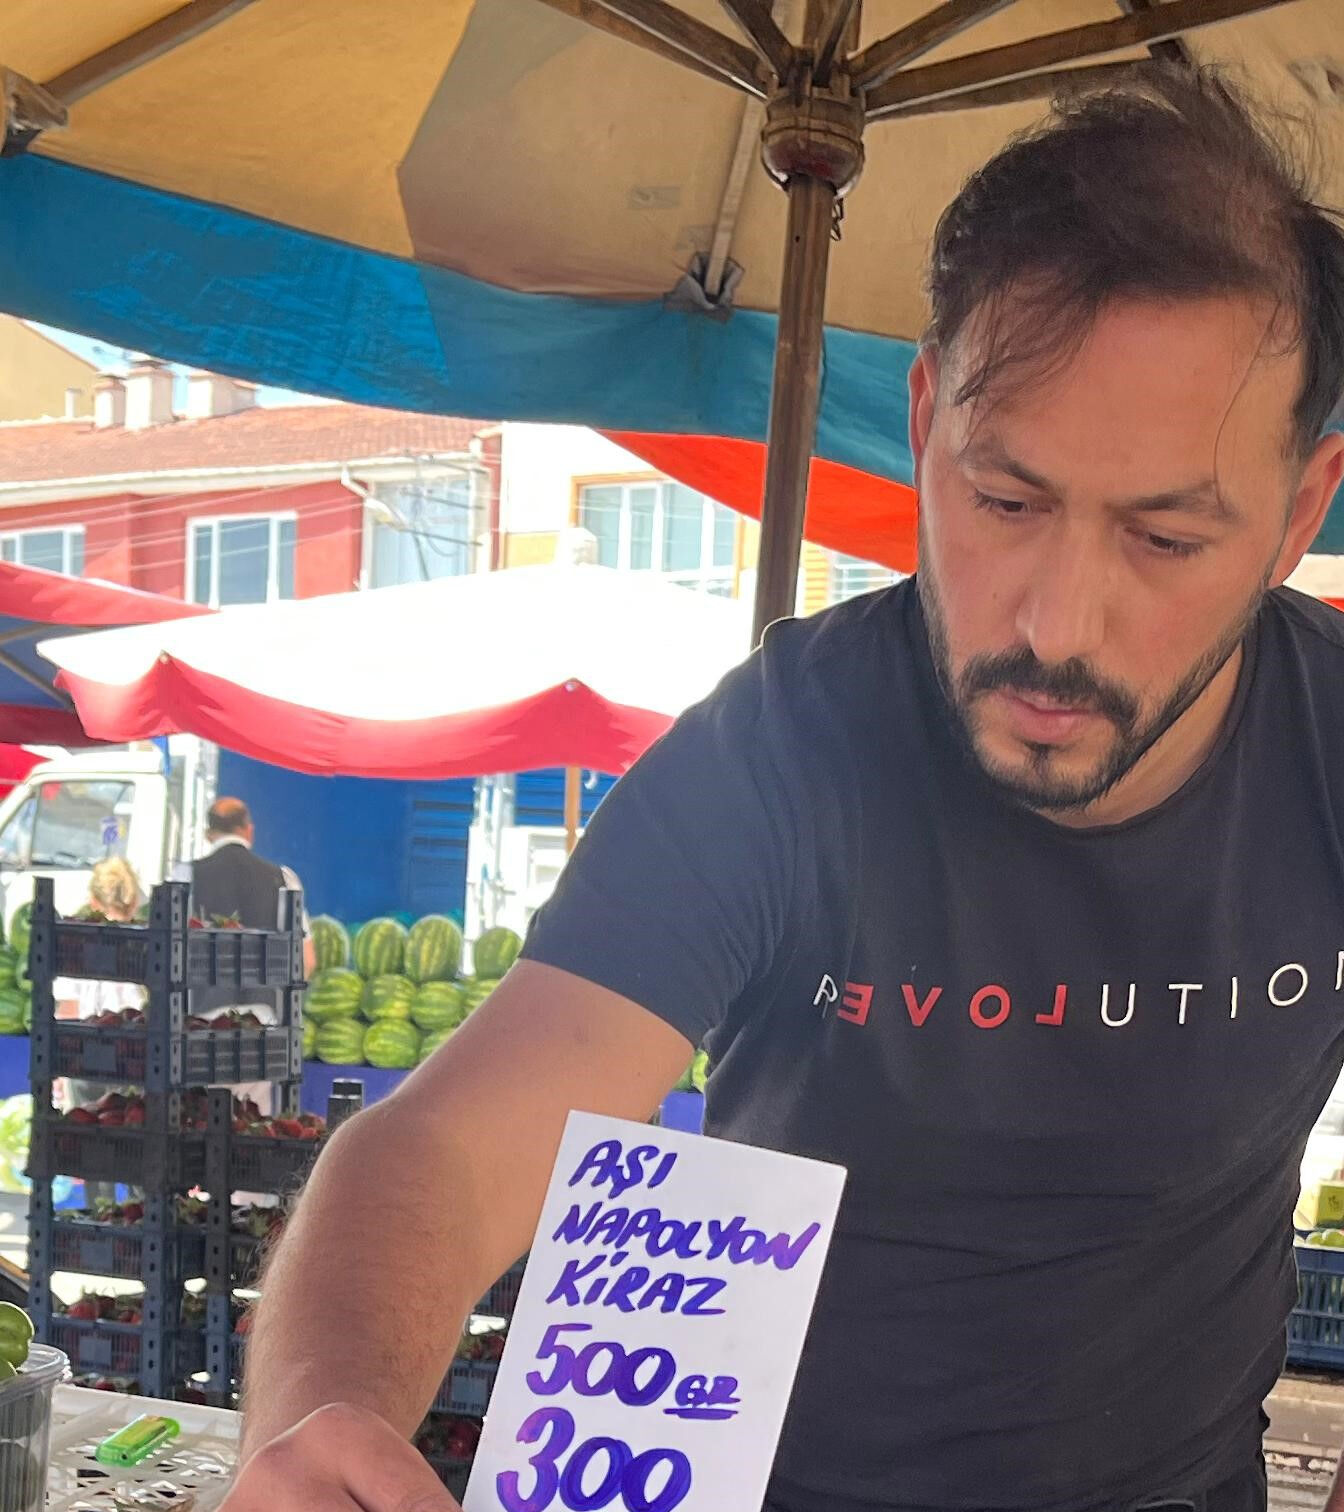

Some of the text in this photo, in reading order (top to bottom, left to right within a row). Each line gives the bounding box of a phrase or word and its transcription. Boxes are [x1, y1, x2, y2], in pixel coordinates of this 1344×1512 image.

[568, 1139, 677, 1199] AŞI
[553, 1202, 821, 1270] NAPOLYON
[546, 1251, 727, 1316] KİRAZ
[526, 1323, 676, 1406] 500
